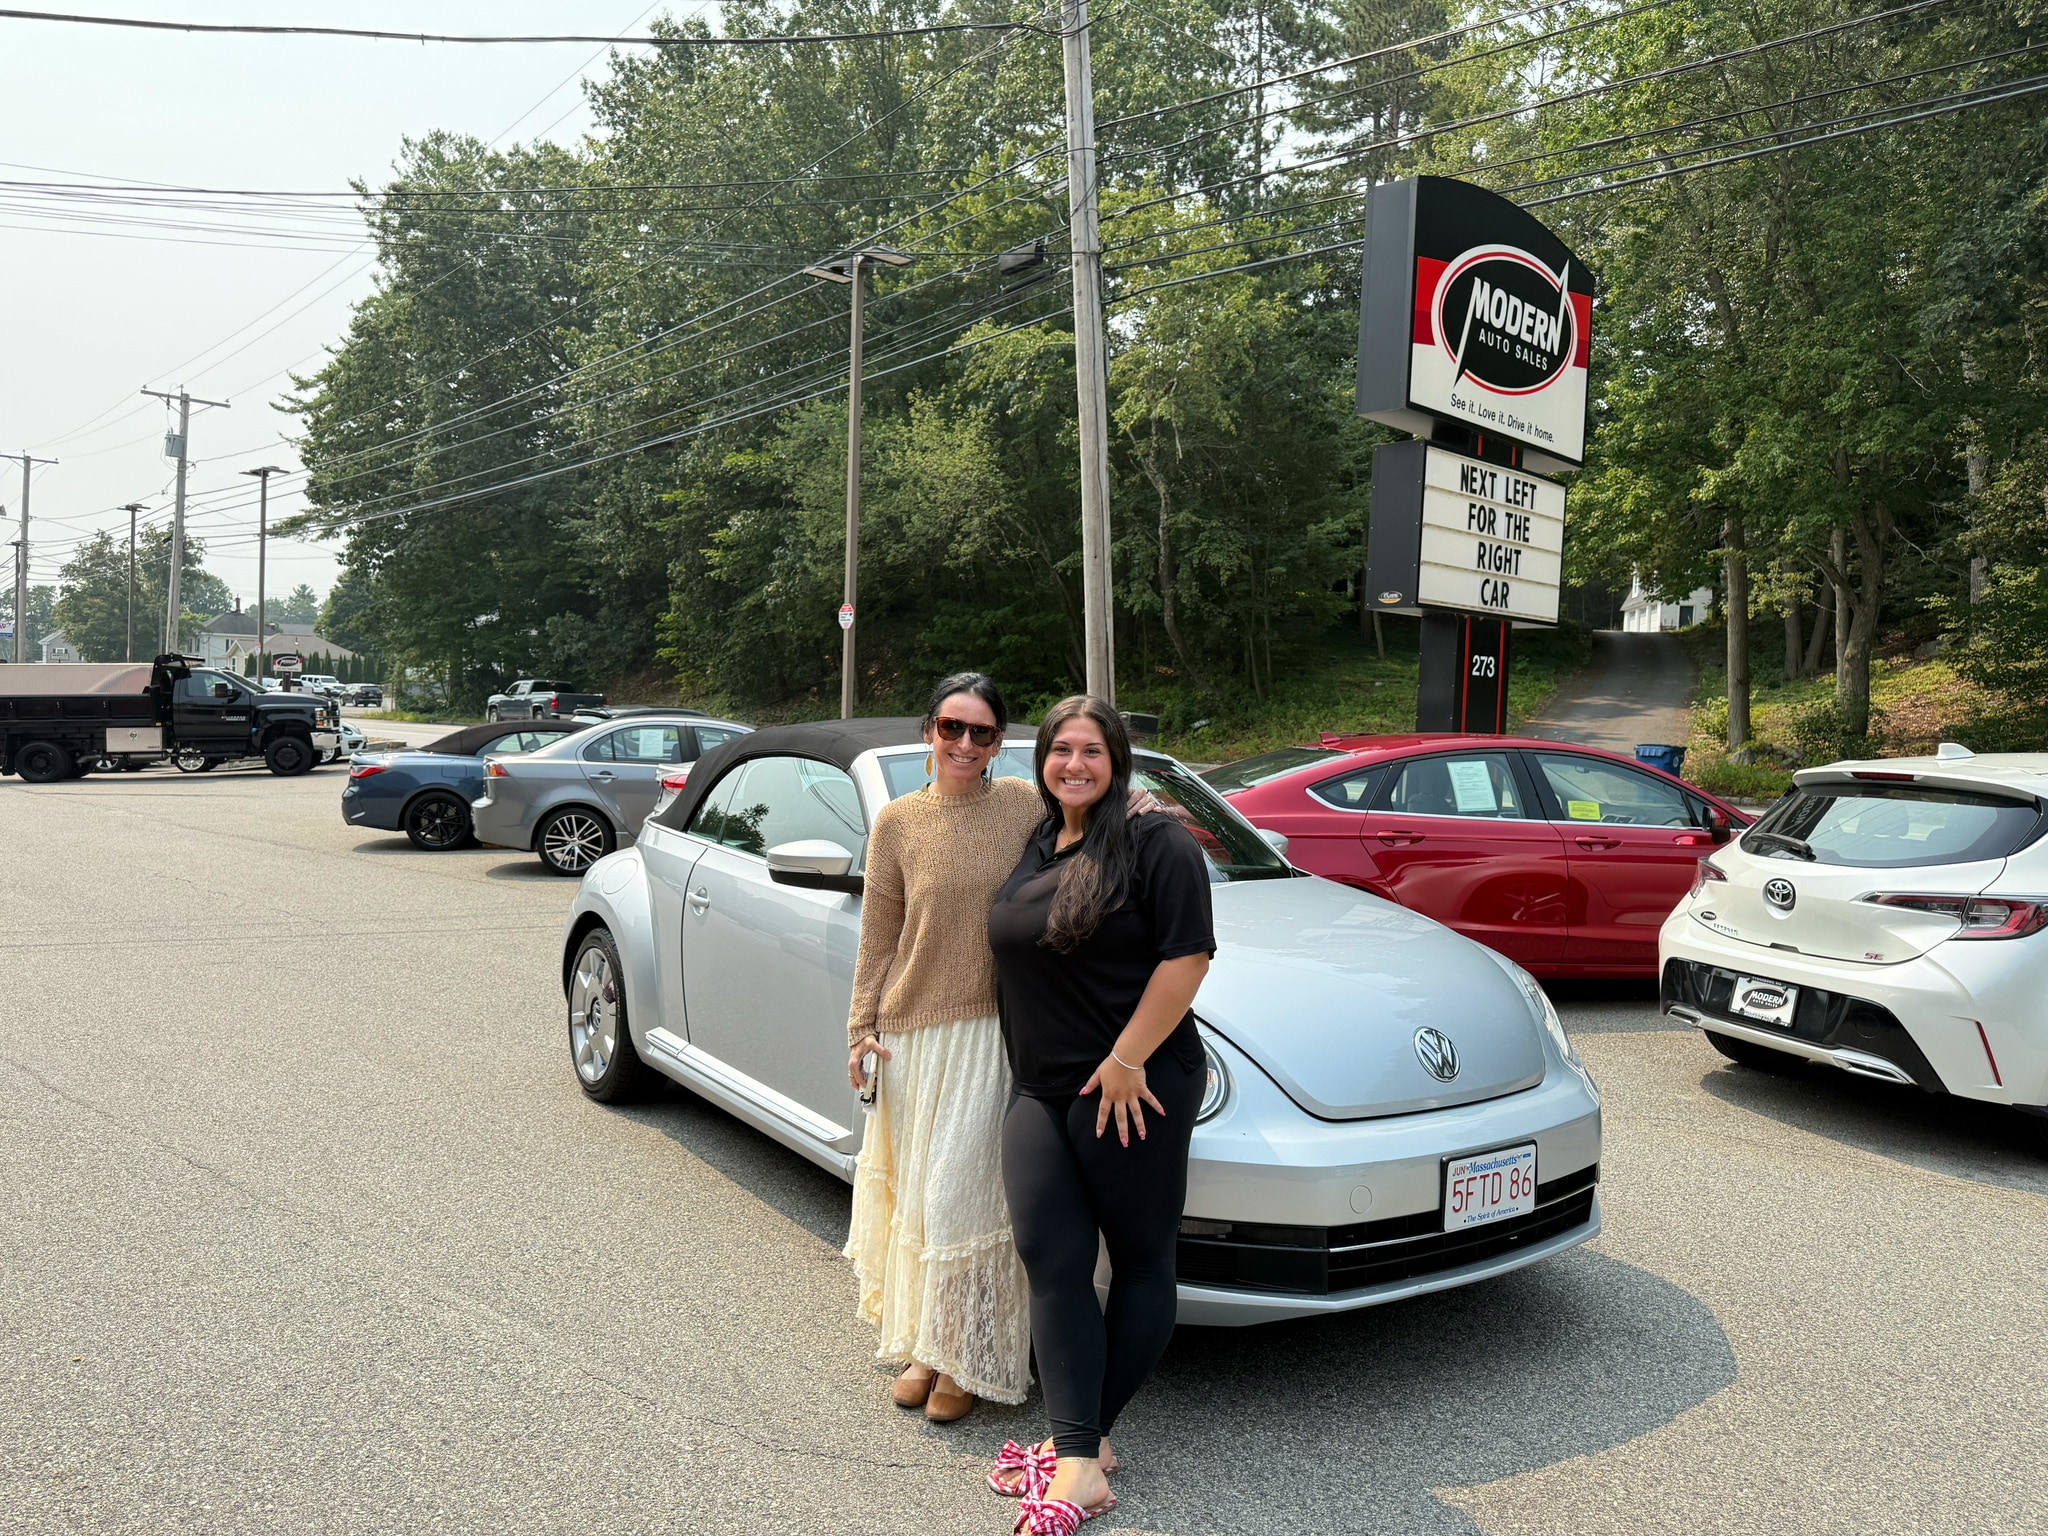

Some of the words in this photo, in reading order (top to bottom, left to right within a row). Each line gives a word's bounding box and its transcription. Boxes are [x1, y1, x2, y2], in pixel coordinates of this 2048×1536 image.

[1466, 275, 1565, 358] MODERN
[1479, 328, 1509, 354] AUTO
[1515, 344, 1548, 371] SALES
[1450, 393, 1466, 411] See
[1468, 399, 1476, 415] it.
[1478, 403, 1496, 421] Love
[1498, 410, 1506, 425] it.
[1507, 414, 1525, 432] Drive
[1526, 421, 1533, 436] it
[1534, 424, 1555, 443] home.
[1460, 463, 1498, 499] NEXT
[1505, 476, 1537, 510] LEFT
[1468, 503, 1496, 536] FOR
[1505, 512, 1530, 543] THE
[1477, 542, 1522, 576] RIGHT
[1480, 578, 1510, 609] CAR
[1471, 655, 1496, 678] 273
[1864, 952, 1884, 960] SE
[1750, 990, 1785, 1006] MODERN
[1452, 1166, 1466, 1177] JUN
[1468, 1156, 1518, 1174] Massachusetts
[1452, 1171, 1502, 1213] 5FTD
[1509, 1164, 1533, 1200] 86
[1477, 1212, 1490, 1221] Spirit
[1490, 1210, 1497, 1218] of
[1496, 1206, 1516, 1217] America
